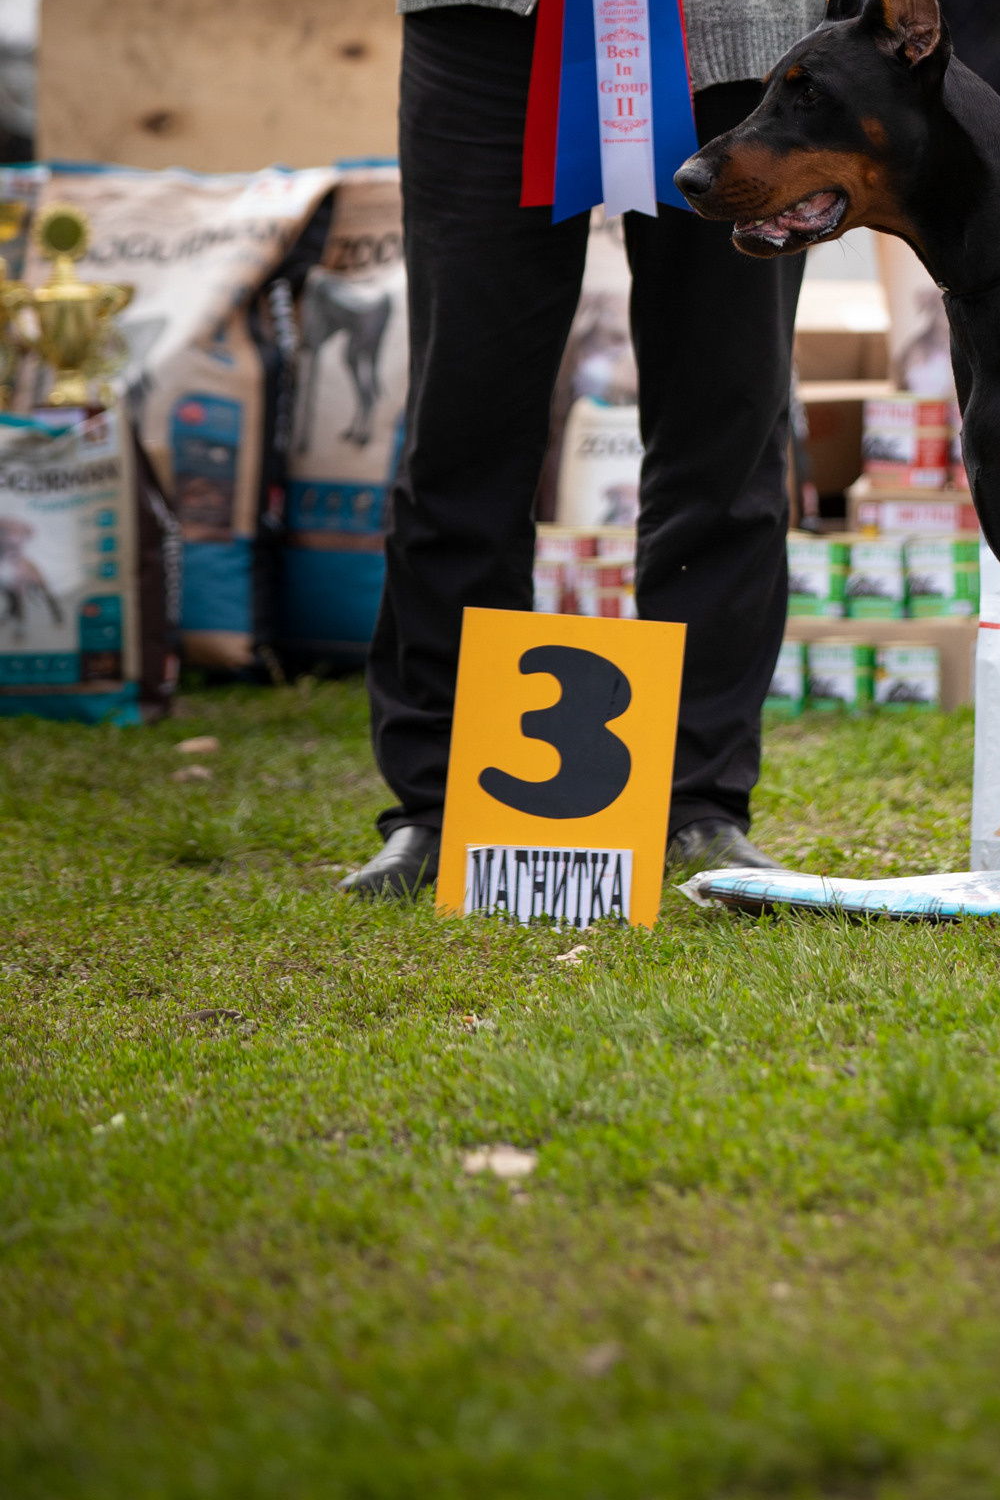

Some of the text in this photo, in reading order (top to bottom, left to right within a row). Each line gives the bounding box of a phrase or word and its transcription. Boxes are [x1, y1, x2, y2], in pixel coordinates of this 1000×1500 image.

[607, 45, 640, 59] Best
[615, 62, 632, 76] In
[599, 80, 649, 96] Group
[616, 98, 634, 116] II
[478, 643, 633, 820] 3
[472, 847, 625, 928] МАГНИТКА
